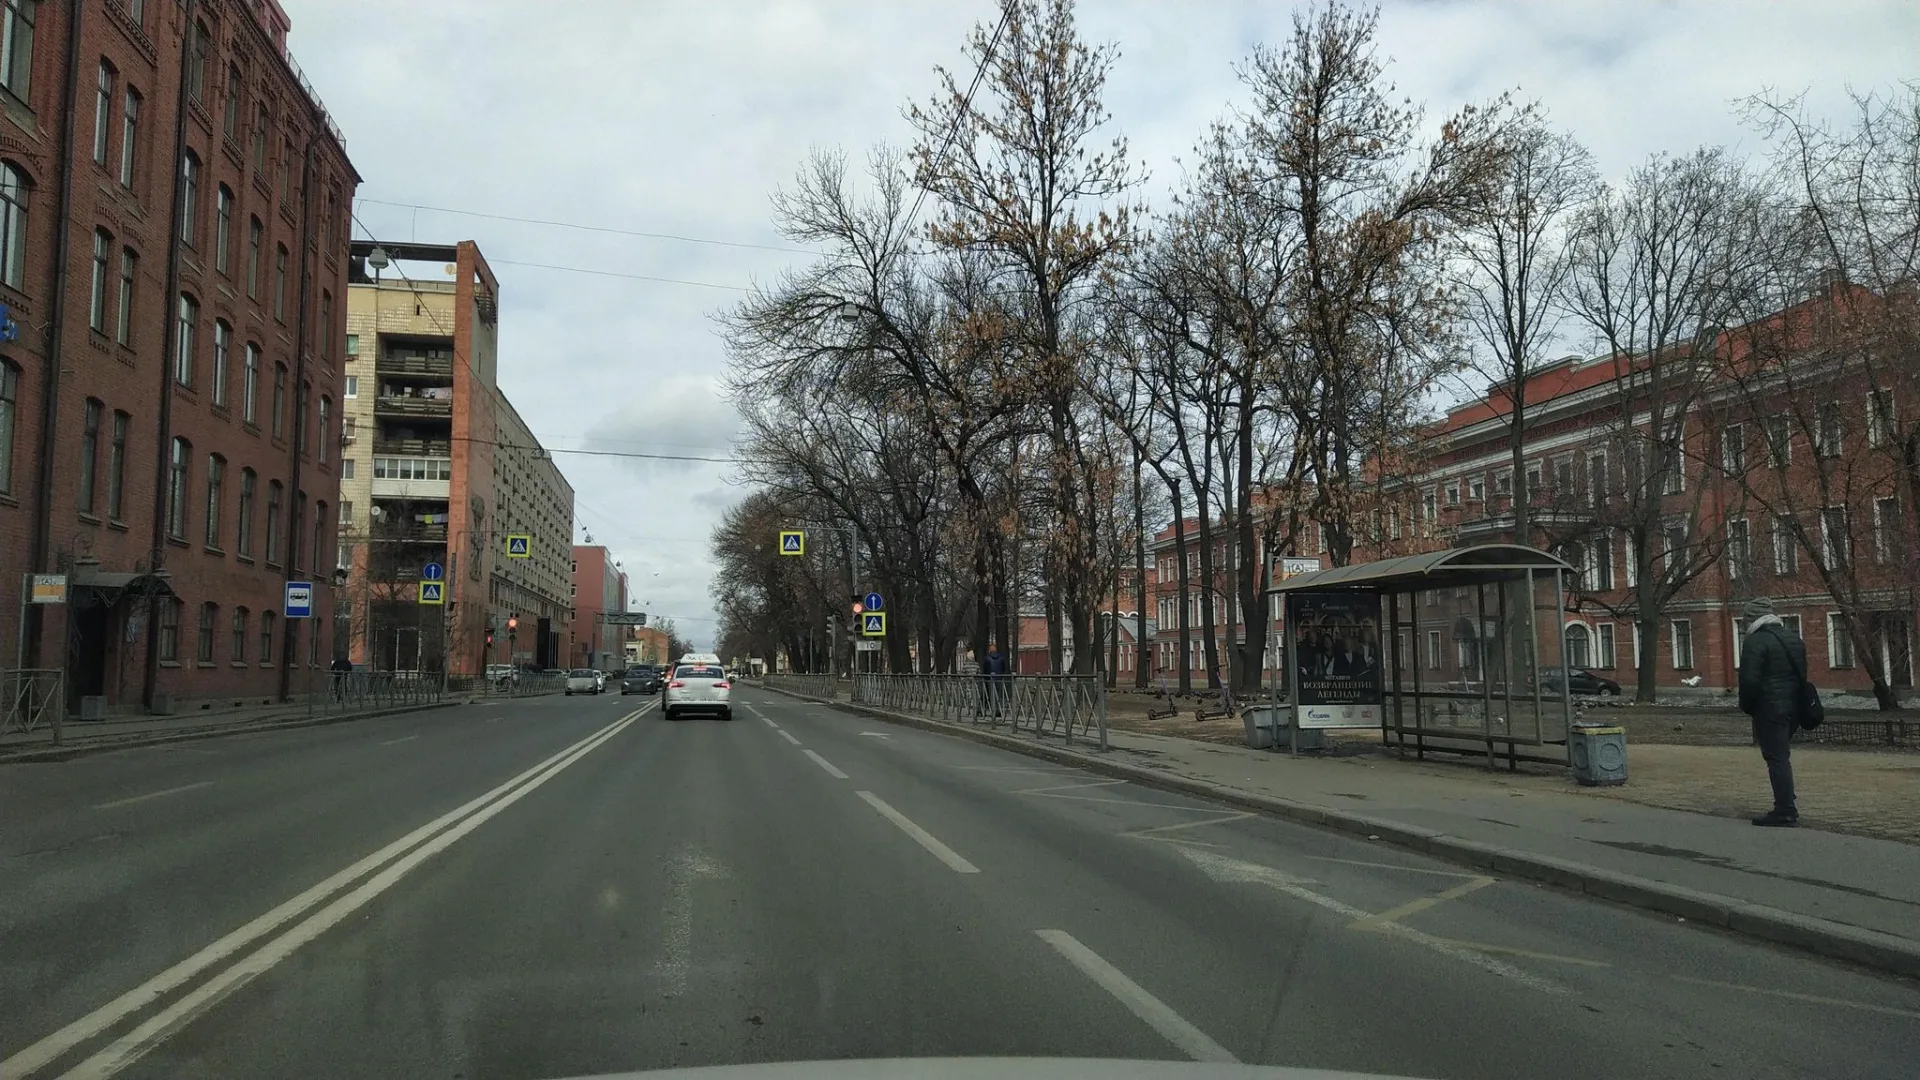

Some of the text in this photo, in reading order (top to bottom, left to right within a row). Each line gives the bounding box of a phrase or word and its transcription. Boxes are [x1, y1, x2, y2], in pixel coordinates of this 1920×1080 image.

[1304, 599, 1310, 608] 2
[1303, 681, 1373, 689] ВОЗВРАЩЕНИЕ
[1317, 690, 1361, 699] ЛЕГЕНДЫ
